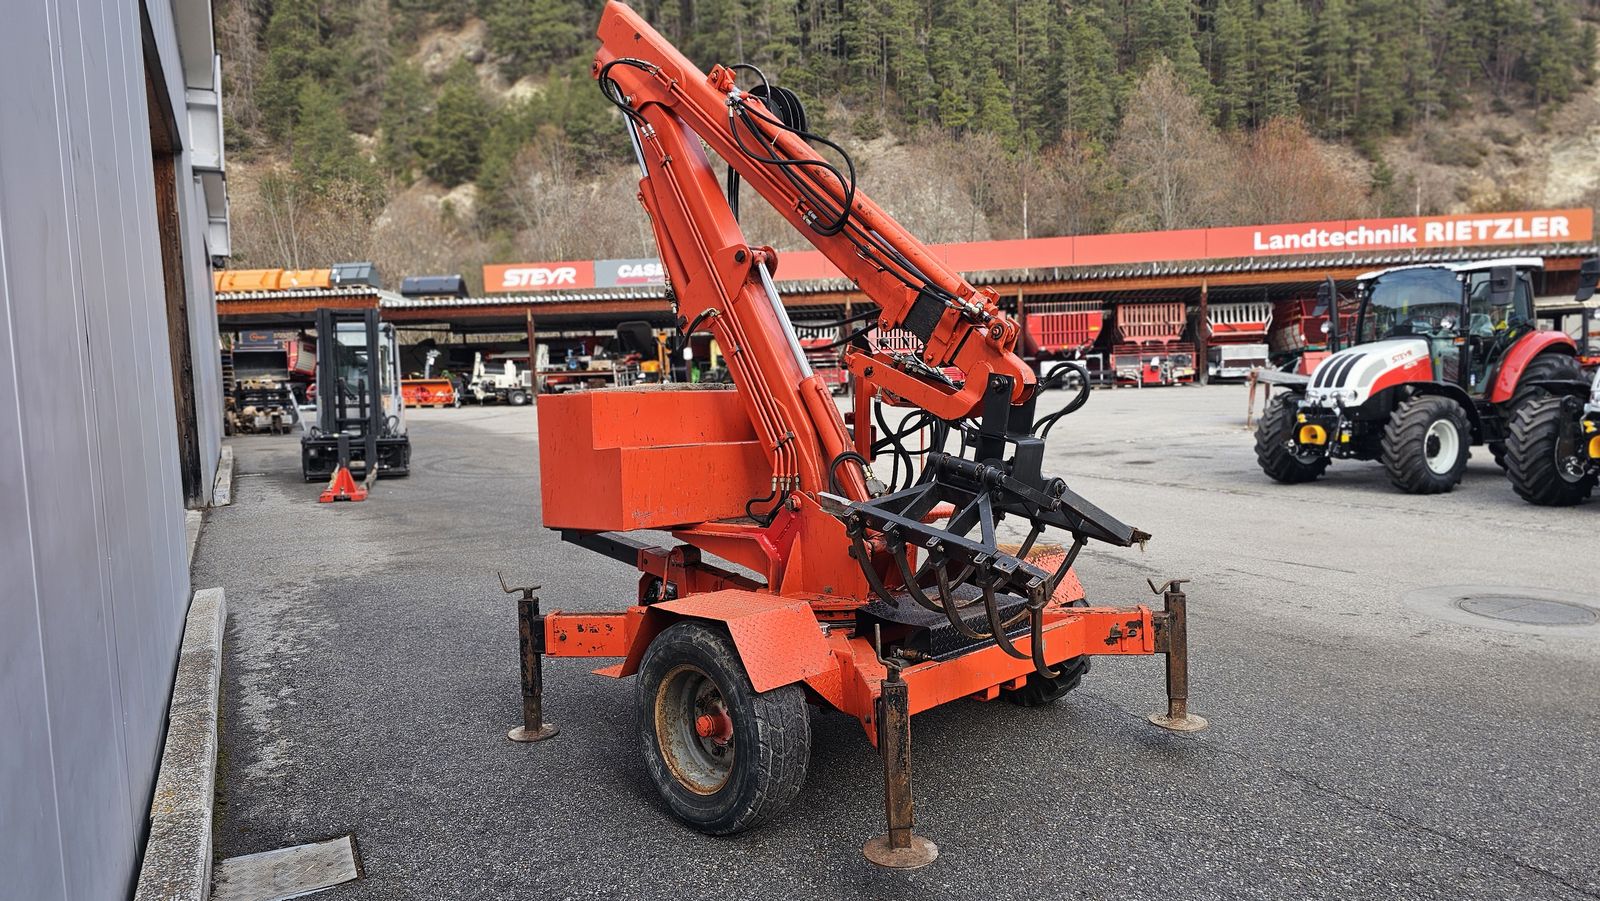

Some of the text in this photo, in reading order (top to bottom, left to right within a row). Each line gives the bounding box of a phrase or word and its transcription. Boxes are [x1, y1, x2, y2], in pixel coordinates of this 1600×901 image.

[1253, 215, 1570, 251] Landtechnik RIETZLER
[502, 266, 577, 287] STEYR
